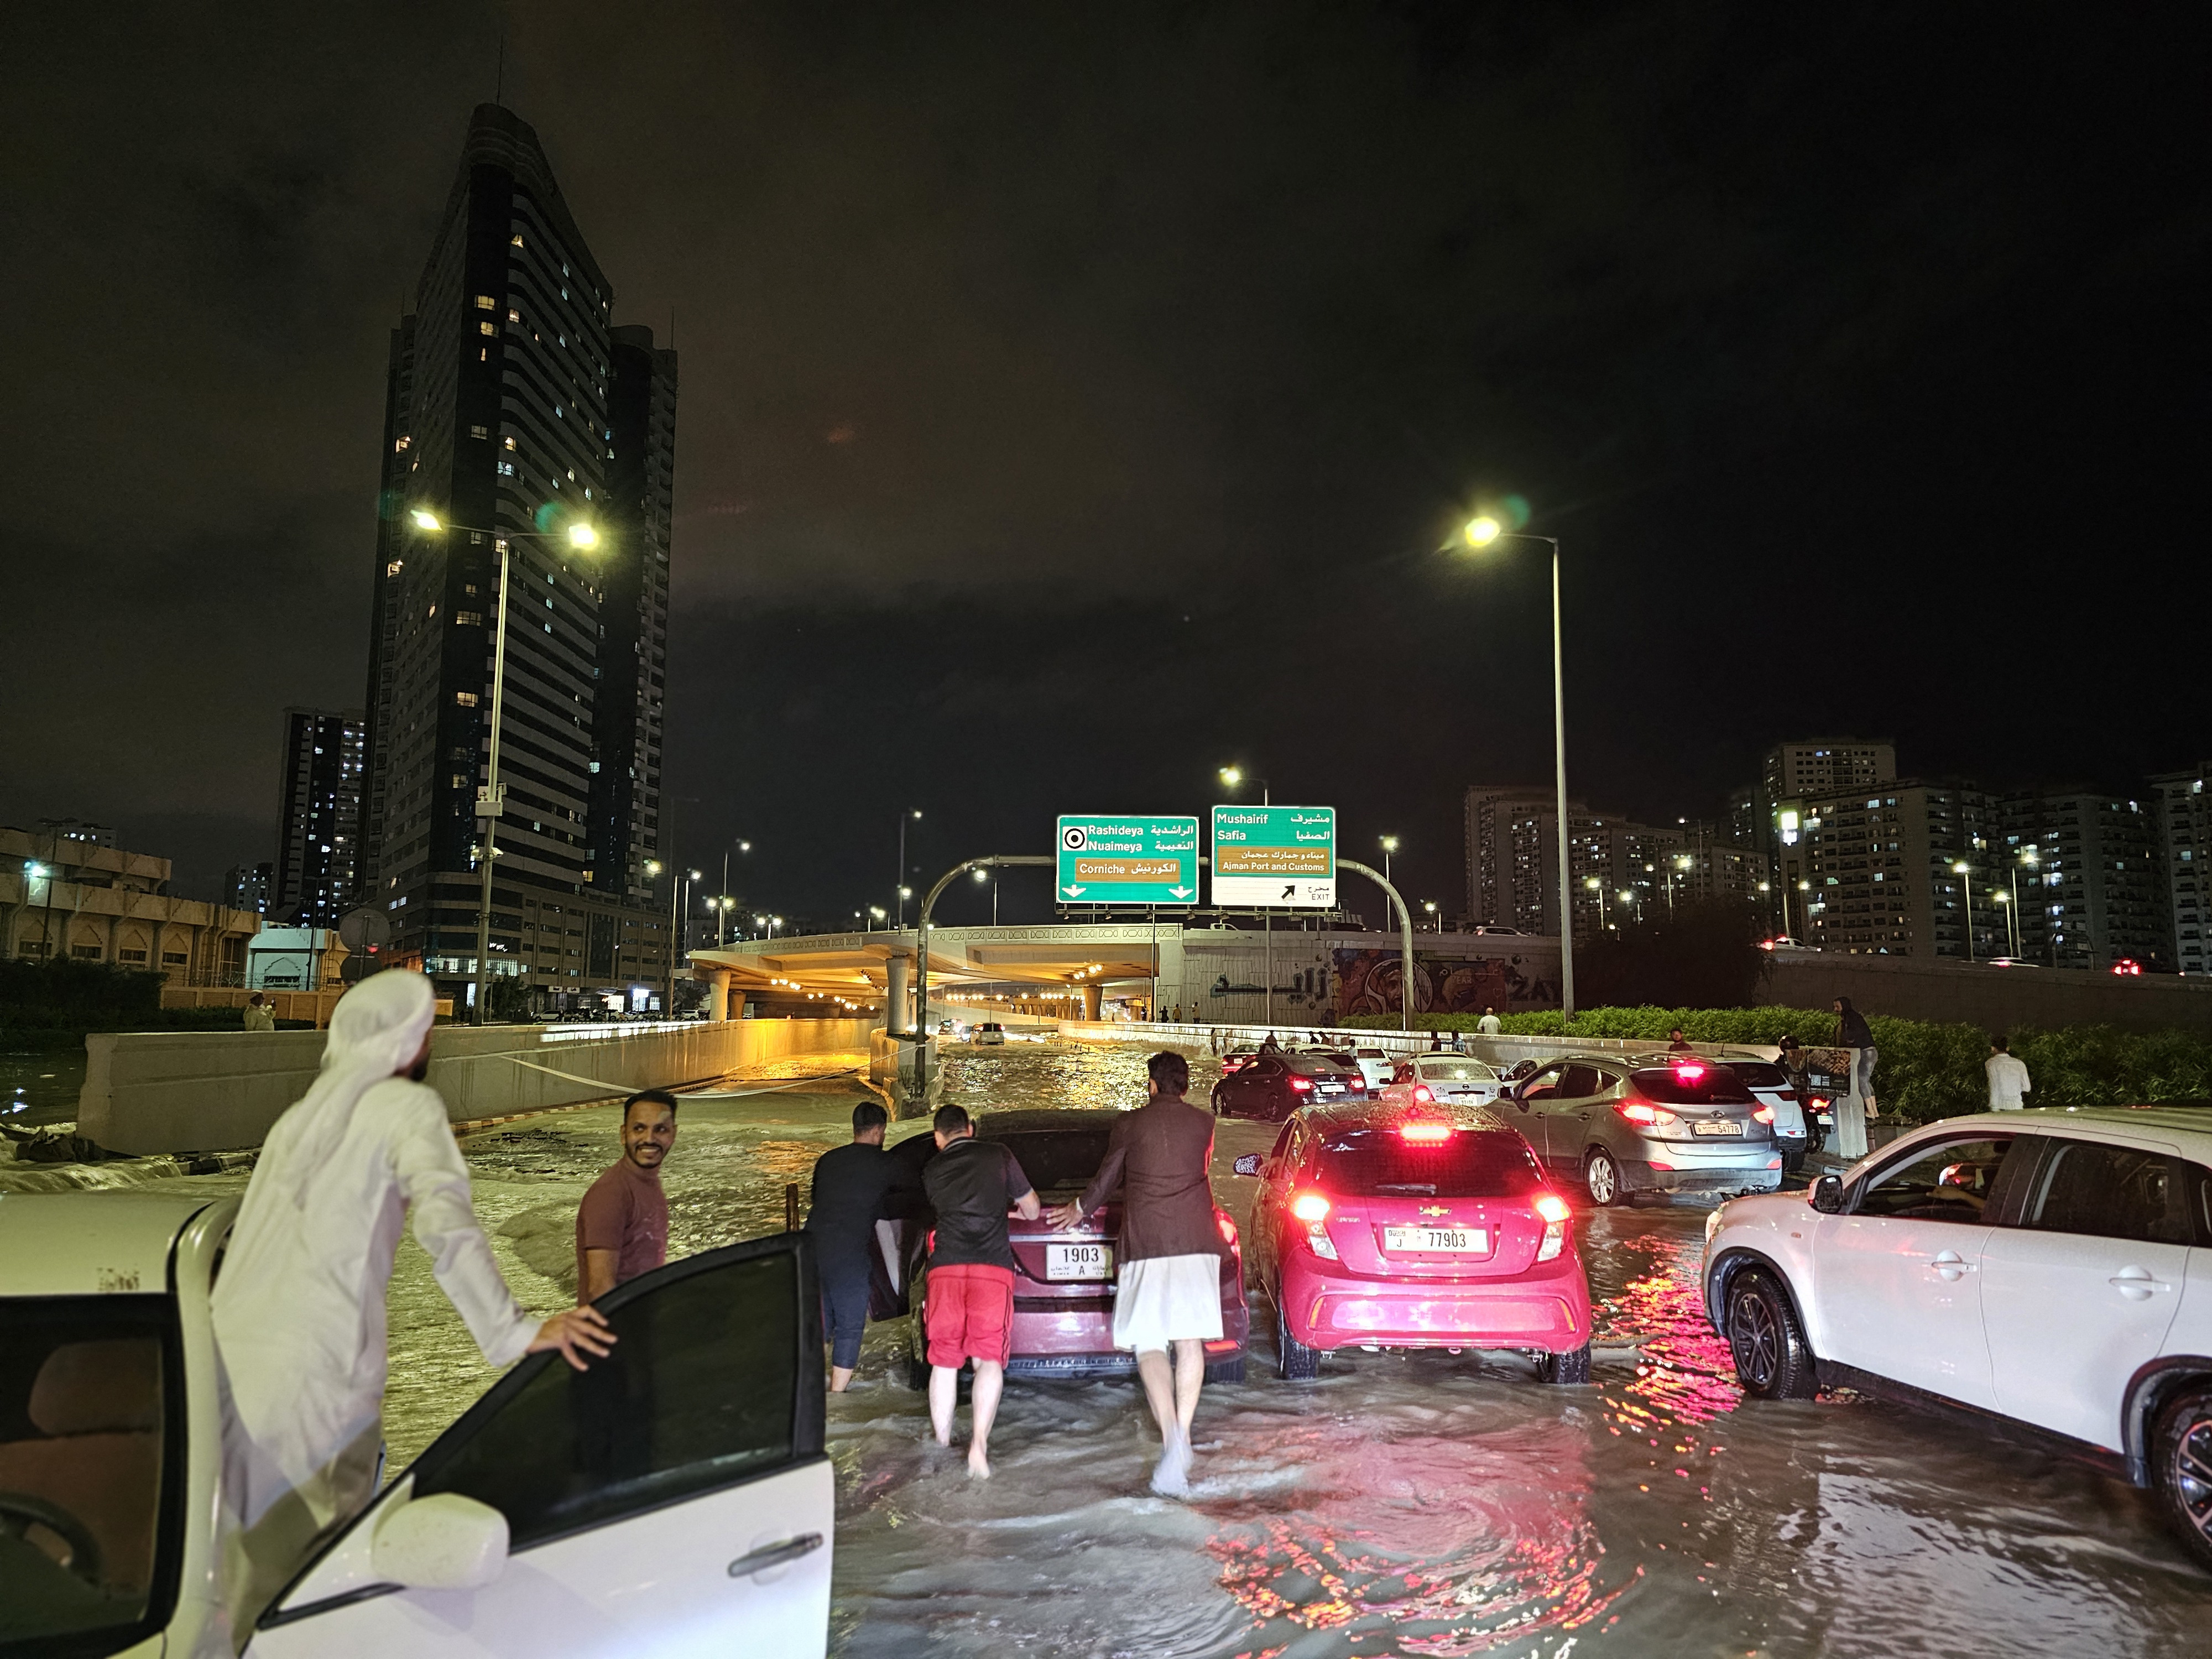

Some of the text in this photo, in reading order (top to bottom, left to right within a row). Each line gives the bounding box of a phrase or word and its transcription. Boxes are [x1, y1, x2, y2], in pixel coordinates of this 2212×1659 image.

[1217, 813, 1269, 824] Mushairif
[1290, 813, 1330, 825] مشيرف
[1088, 825, 1144, 837] Rashideya
[1150, 825, 1193, 837] الراشدية
[1217, 830, 1246, 841] Safia
[1296, 830, 1330, 842] الصفيا
[1088, 841, 1142, 853] Nuaimeya
[1155, 841, 1193, 852] النعيمية
[1241, 850, 1269, 859] عجمان
[1271, 851, 1298, 860] جمارك
[1079, 863, 1125, 874] Corniche
[1131, 863, 1176, 874] الكورنيش
[1223, 862, 1324, 871] Ajman Port and Customs
[1428, 1232, 1466, 1248] 77903
[1063, 1248, 1099, 1262] 1903
[1079, 1265, 1085, 1275] A
